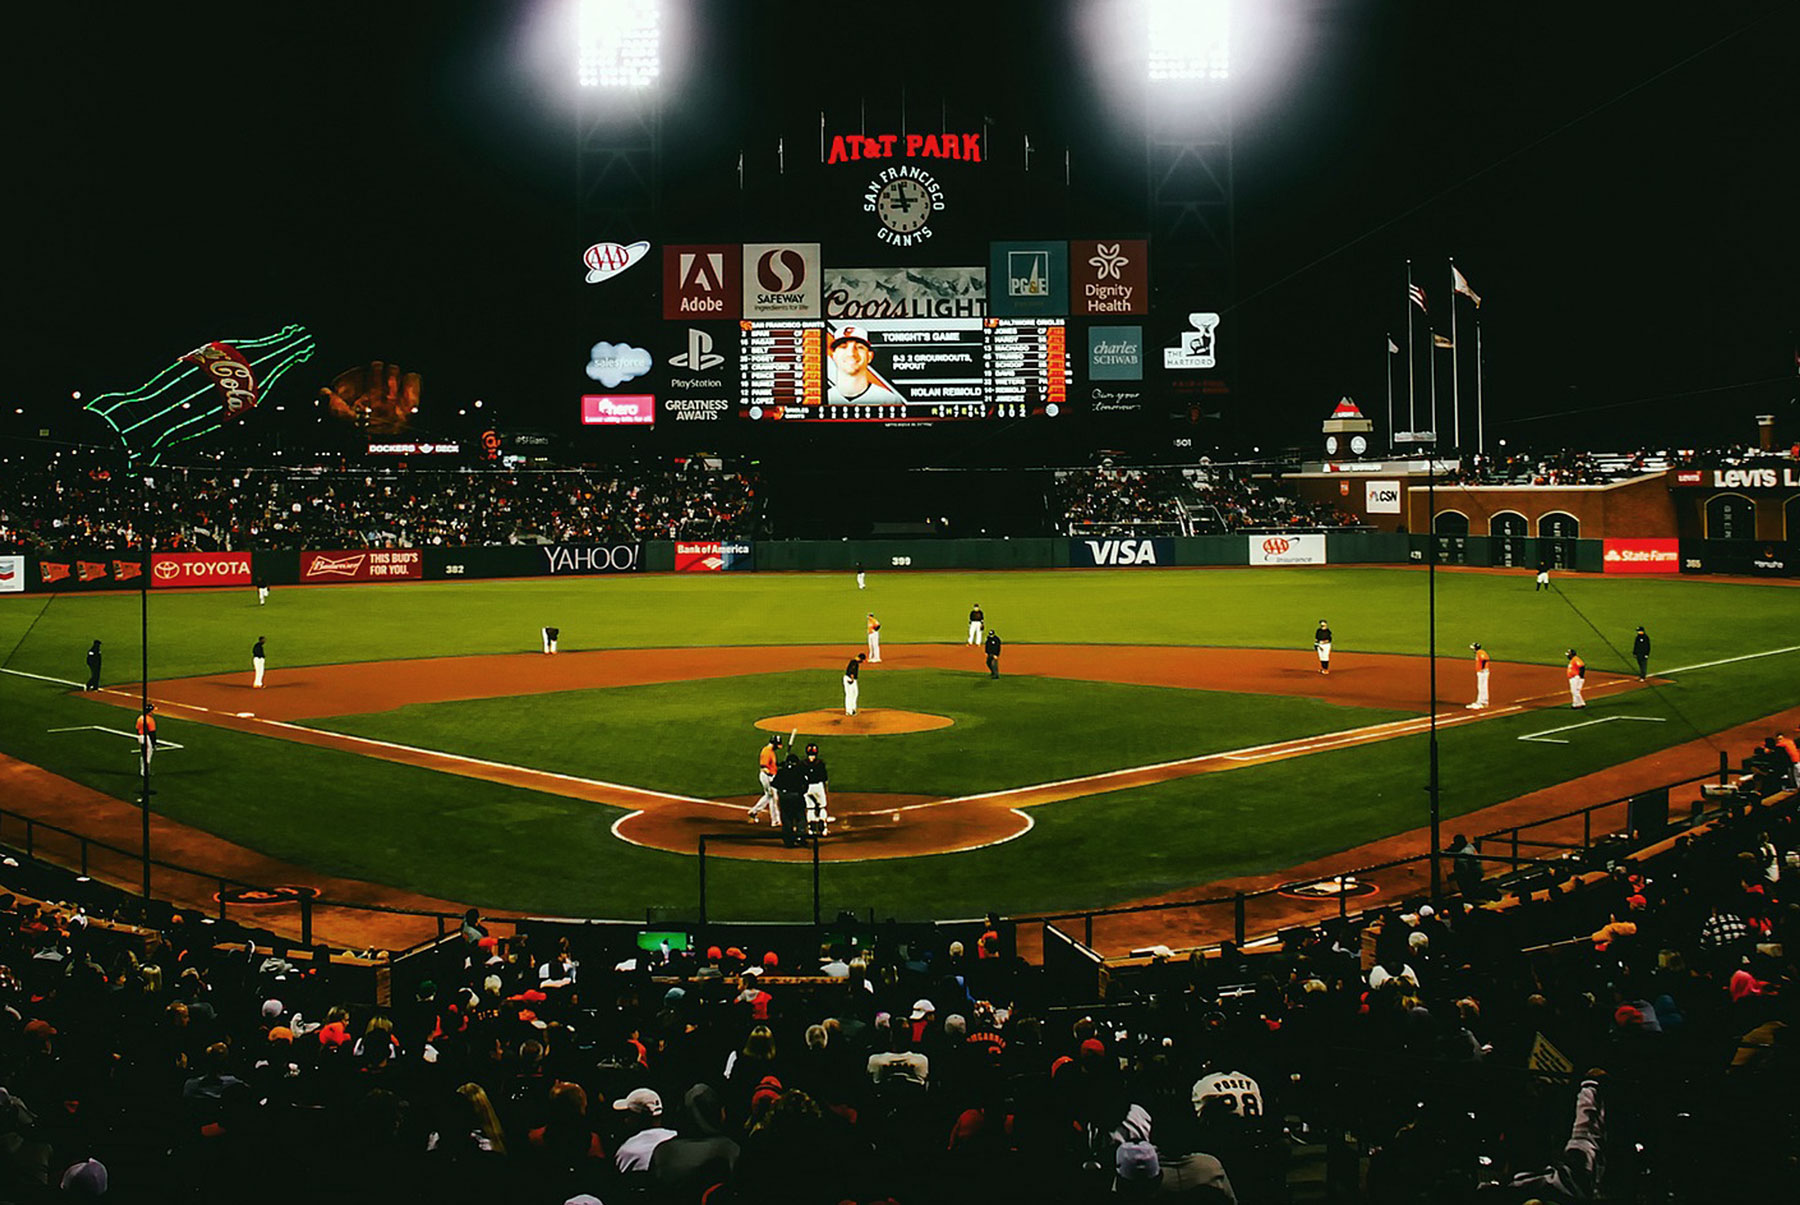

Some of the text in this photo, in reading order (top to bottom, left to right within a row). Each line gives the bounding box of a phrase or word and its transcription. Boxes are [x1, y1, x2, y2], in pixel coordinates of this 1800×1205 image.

[828, 133, 981, 164] AT&T PARK
[863, 165, 945, 211] SAN FRANCISCO
[877, 226, 932, 246] GIANTS
[588, 245, 628, 271] AAA
[1011, 278, 1046, 294] PG&E
[1086, 284, 1132, 300] Dignity
[680, 298, 723, 312] Adobe
[757, 294, 805, 304] SAFEWAY
[825, 289, 986, 318] Coors LIGHT
[754, 304, 790, 312] ingredients
[1088, 300, 1131, 312] Health
[882, 333, 960, 342] TONIGHT'S GAME
[1094, 341, 1137, 354] charles
[595, 357, 645, 369] salesforce
[893, 362, 926, 370] POPOUT
[1094, 355, 1138, 365] SCHWAB
[210, 361, 256, 413] Cola
[671, 379, 721, 390] PlayStation
[911, 387, 982, 397] NOLAN REIMOLD
[1092, 388, 1140, 403] Own your
[665, 400, 728, 411] GREATNESS
[676, 411, 718, 420] AWAITS
[369, 445, 416, 453] DOCKERS
[1379, 491, 1397, 501] CSN
[677, 544, 749, 554] Bank of America
[1085, 540, 1156, 565] VISA
[1264, 538, 1289, 555] AAA
[370, 552, 418, 564] THIS BUD'S
[544, 545, 640, 572] YAHOO!
[1621, 550, 1677, 561] State Farm
[183, 562, 250, 576] TOYOTA
[314, 560, 359, 570] Budweiser
[370, 564, 409, 575] FOR YOU.
[1214, 1079, 1251, 1092] POSEY
